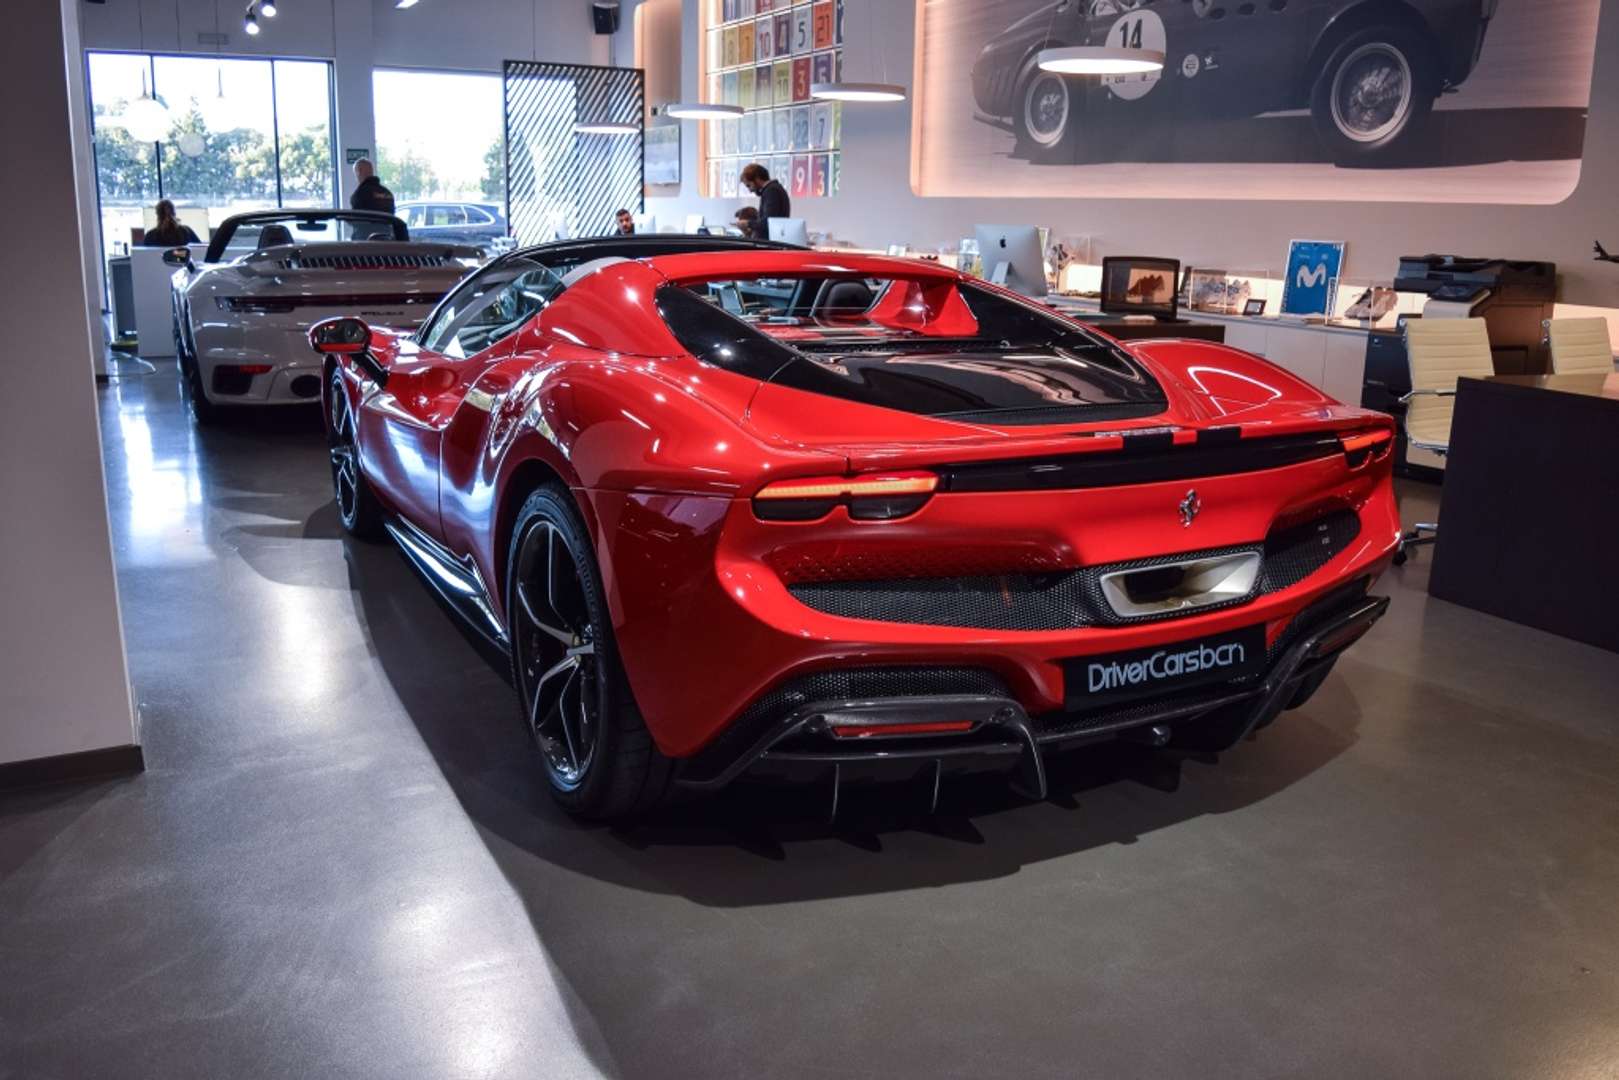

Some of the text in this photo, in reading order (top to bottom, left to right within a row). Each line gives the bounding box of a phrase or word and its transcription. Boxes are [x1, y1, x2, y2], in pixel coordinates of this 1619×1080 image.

[796, 21, 806, 48] 5
[1119, 18, 1143, 49] 14
[798, 68, 806, 97] 3
[796, 166, 805, 193] 9
[817, 170, 825, 197] 3
[1087, 643, 1245, 693] DriverCarsbcn
